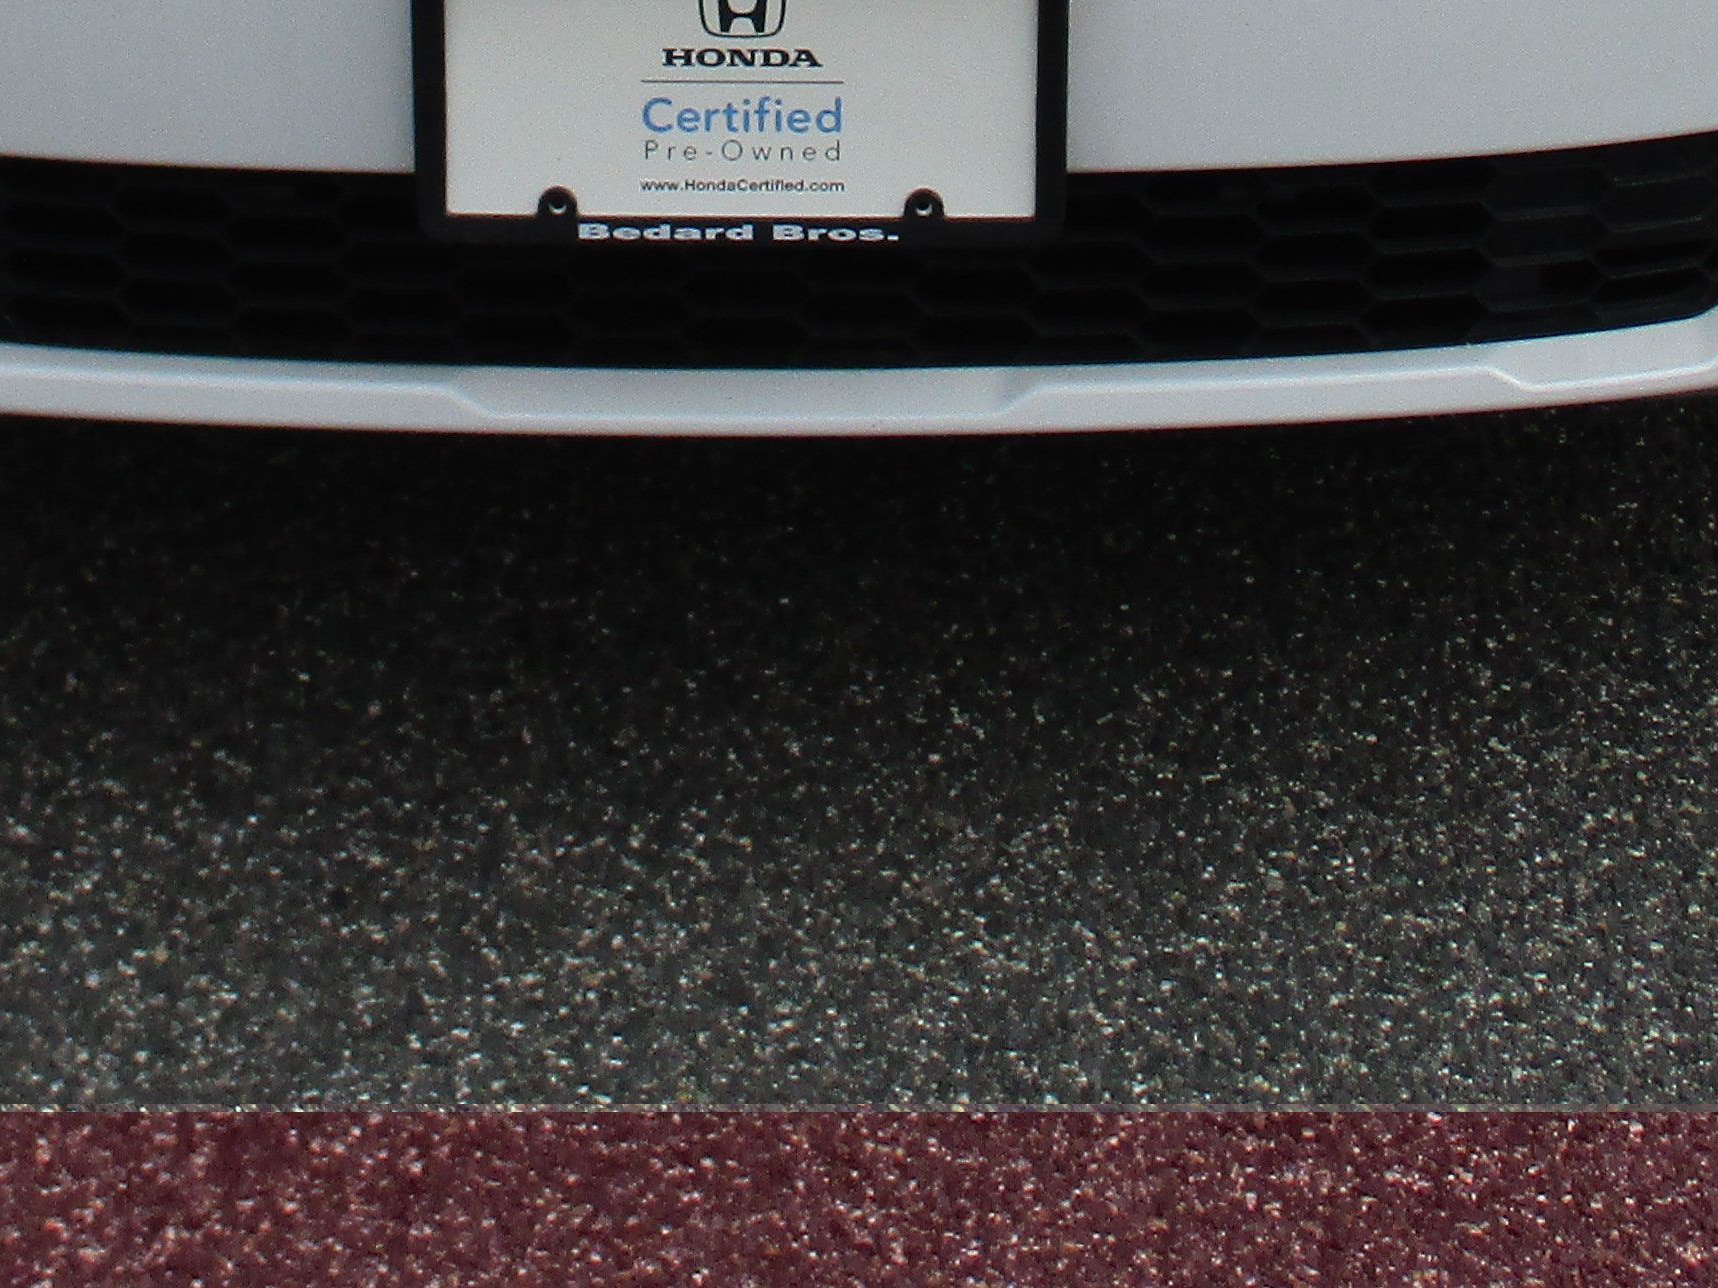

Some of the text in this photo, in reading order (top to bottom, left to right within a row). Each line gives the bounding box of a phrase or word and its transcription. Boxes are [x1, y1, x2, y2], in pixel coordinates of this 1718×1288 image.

[662, 48, 823, 68] HONDA
[642, 96, 843, 133] Certified
[644, 139, 841, 162] Pre-Owned
[640, 179, 845, 193] www.HondaCertified.com
[578, 223, 900, 241] Bedard Bros.
